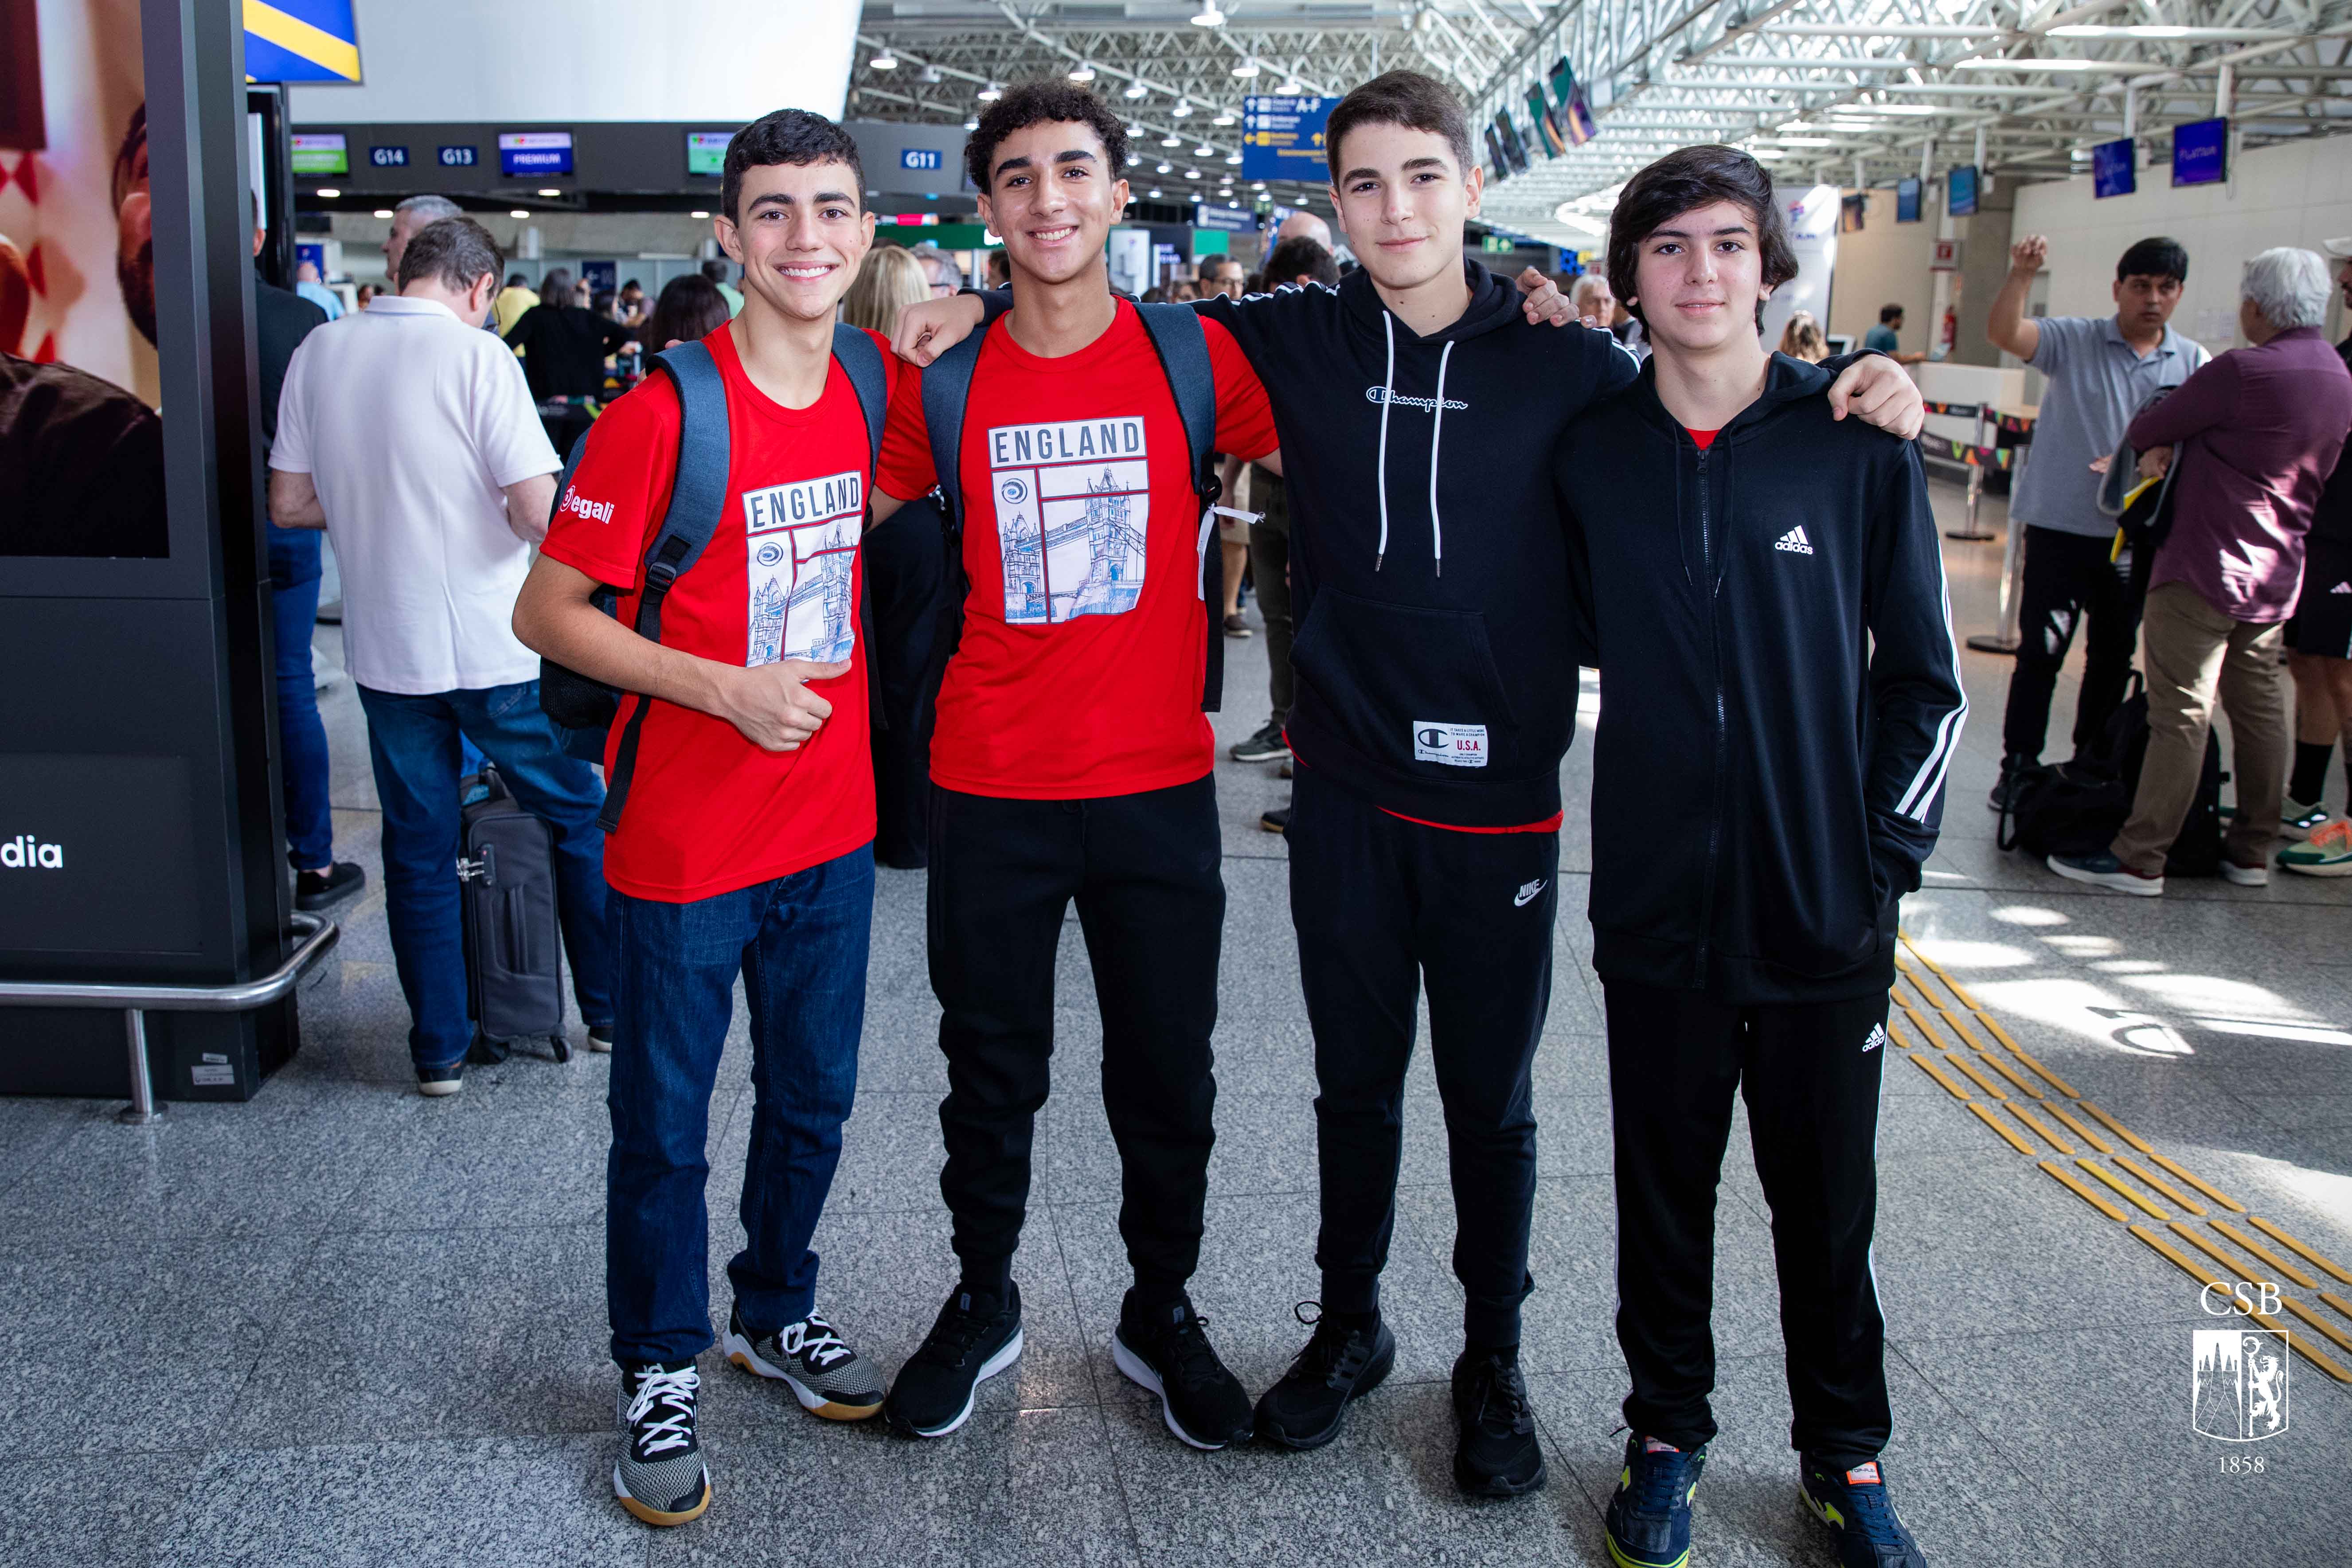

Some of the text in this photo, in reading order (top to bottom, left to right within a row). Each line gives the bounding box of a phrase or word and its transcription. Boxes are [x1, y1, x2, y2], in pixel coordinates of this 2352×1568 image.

[373, 148, 404, 165] G14
[442, 148, 473, 165] G13
[513, 152, 561, 164] PREMIUM
[905, 151, 936, 168] G11
[994, 422, 1140, 463] ENGLAND
[570, 495, 615, 524] egali
[750, 477, 860, 528] ENGLAND
[1774, 541, 1813, 555] adidas
[1457, 740, 1481, 751] U.S.A.
[0, 835, 64, 868] dia
[1519, 879, 1539, 898] NIKE
